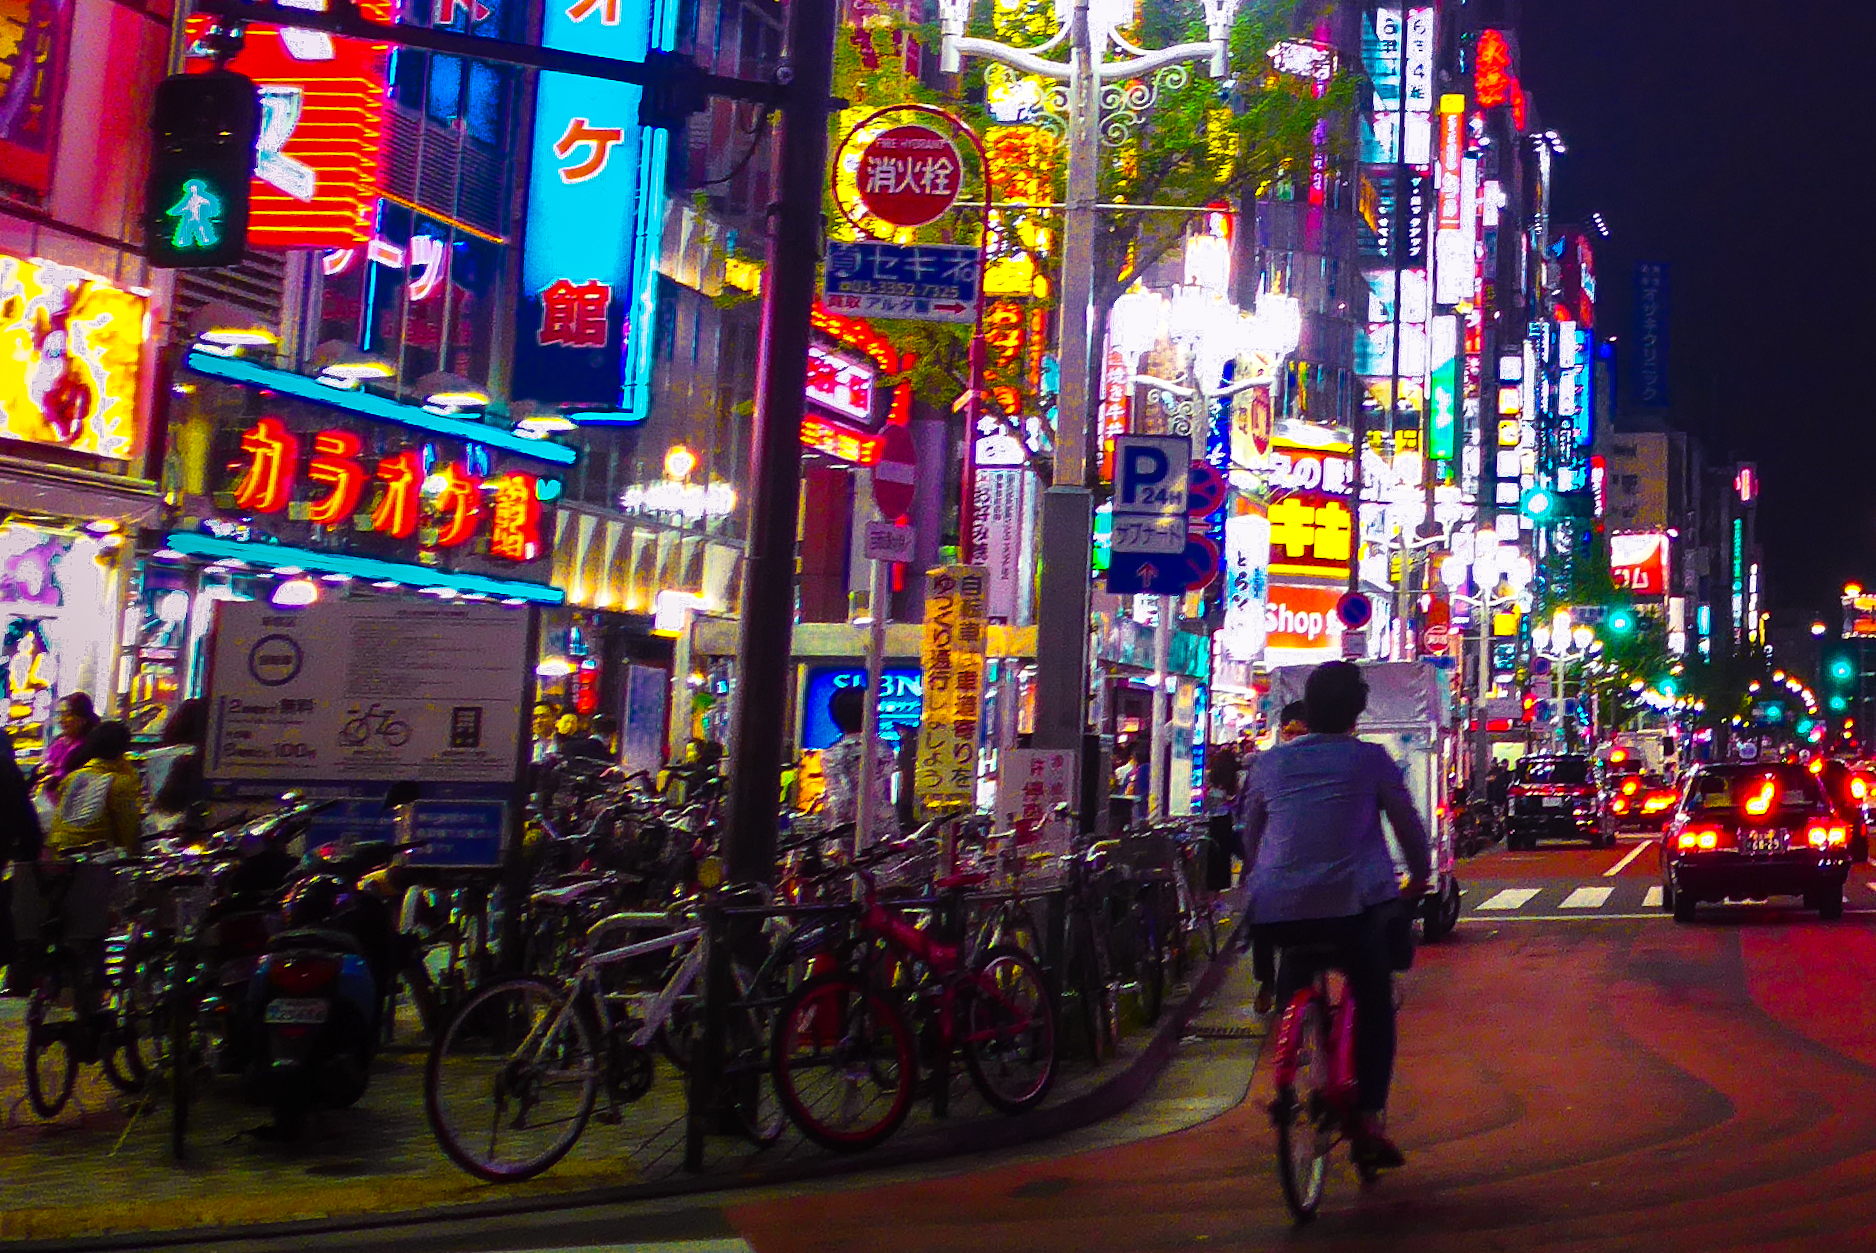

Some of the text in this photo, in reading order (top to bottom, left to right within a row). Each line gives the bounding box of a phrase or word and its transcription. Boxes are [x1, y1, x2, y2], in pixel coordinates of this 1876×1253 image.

[866, 155, 955, 195] 消火栓
[1122, 444, 1168, 504] P
